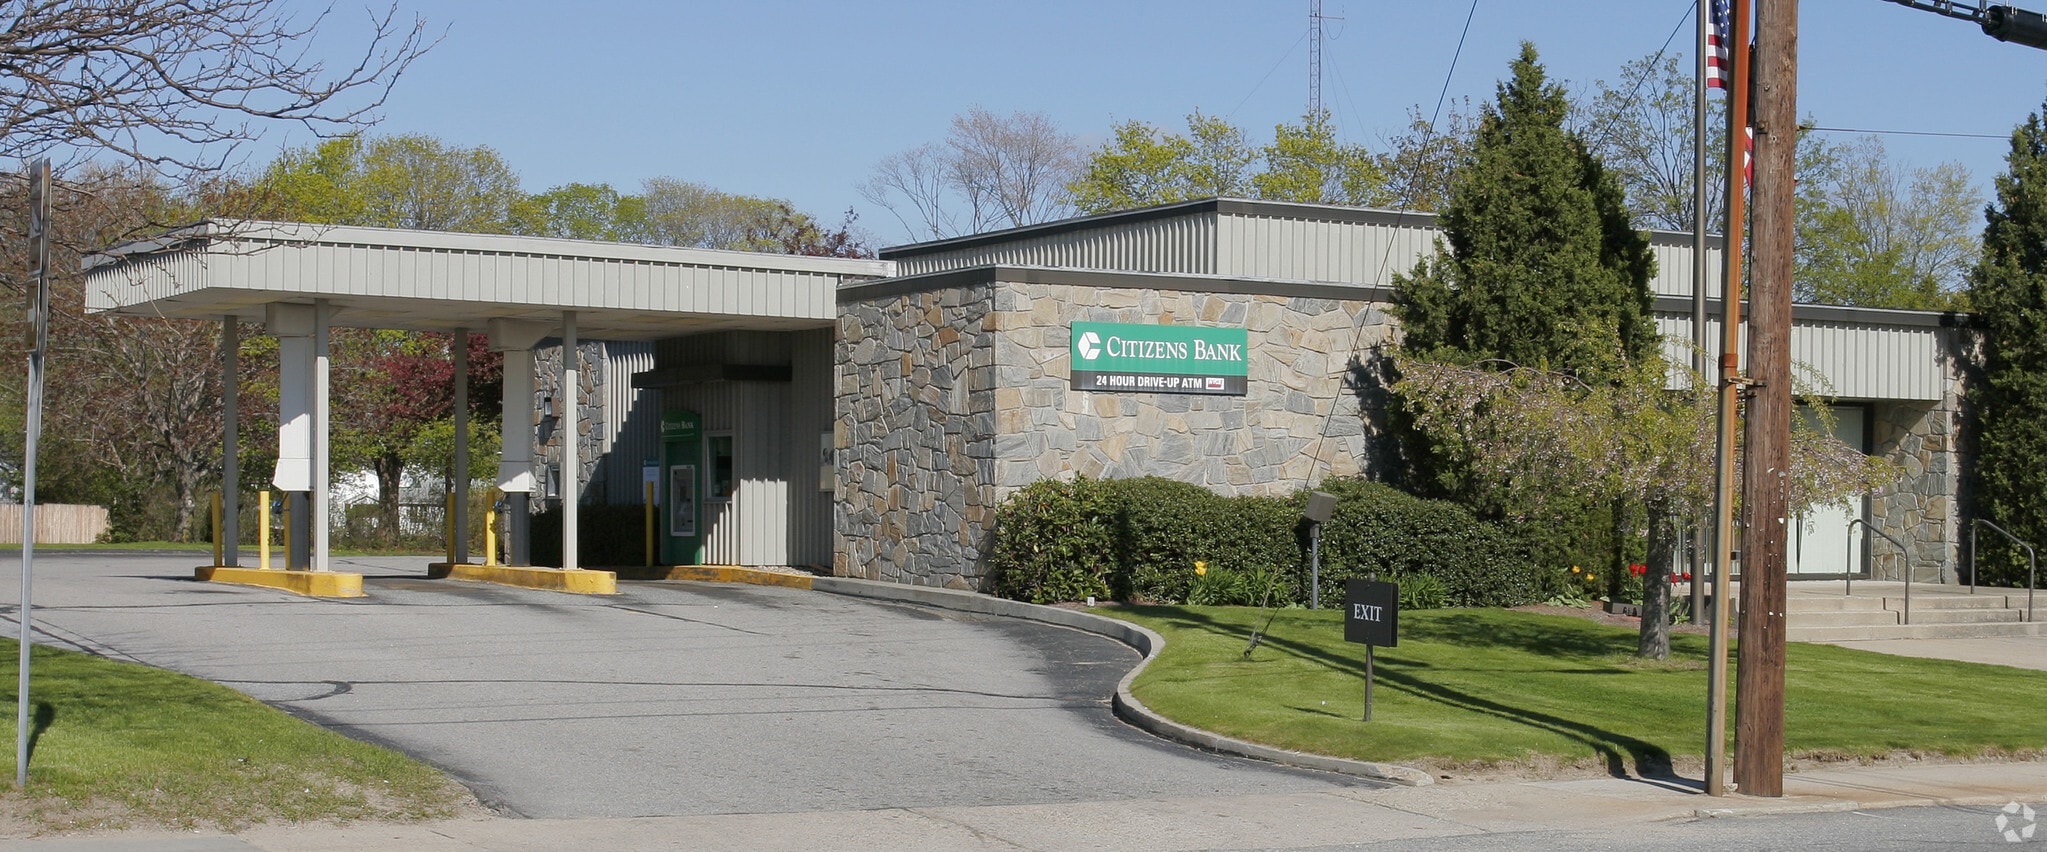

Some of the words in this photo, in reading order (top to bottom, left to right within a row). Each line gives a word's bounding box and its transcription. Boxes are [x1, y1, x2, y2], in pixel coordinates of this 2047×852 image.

[1106, 336, 1188, 360] CITIZENS
[1194, 339, 1242, 361] BANK
[1096, 375, 1107, 386] 24
[1109, 375, 1136, 387] HOUR
[1138, 376, 1180, 388] DRIVE-UP
[1181, 377, 1202, 389] ATM
[1353, 603, 1383, 622] EXIT
